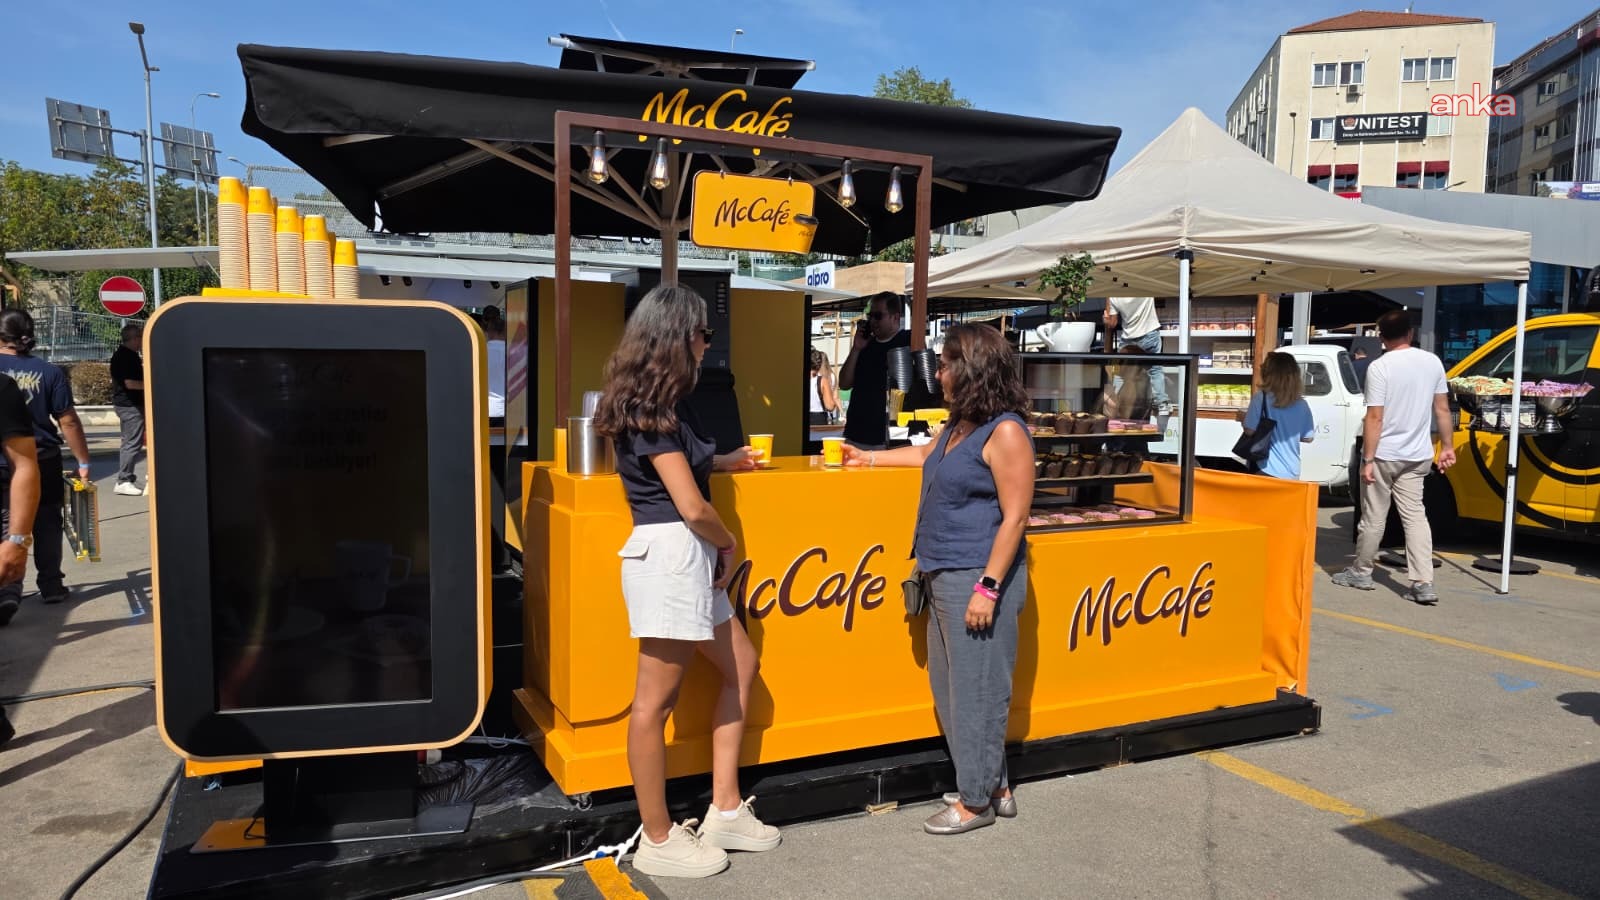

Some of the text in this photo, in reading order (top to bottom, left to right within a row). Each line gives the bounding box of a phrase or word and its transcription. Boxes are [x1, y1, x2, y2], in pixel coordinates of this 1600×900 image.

[638, 87, 793, 156] McCafé
[1341, 115, 1423, 131] UNITEST
[714, 197, 791, 233] McCafé
[807, 267, 829, 287] alpro
[1068, 560, 1215, 652] McCafé
